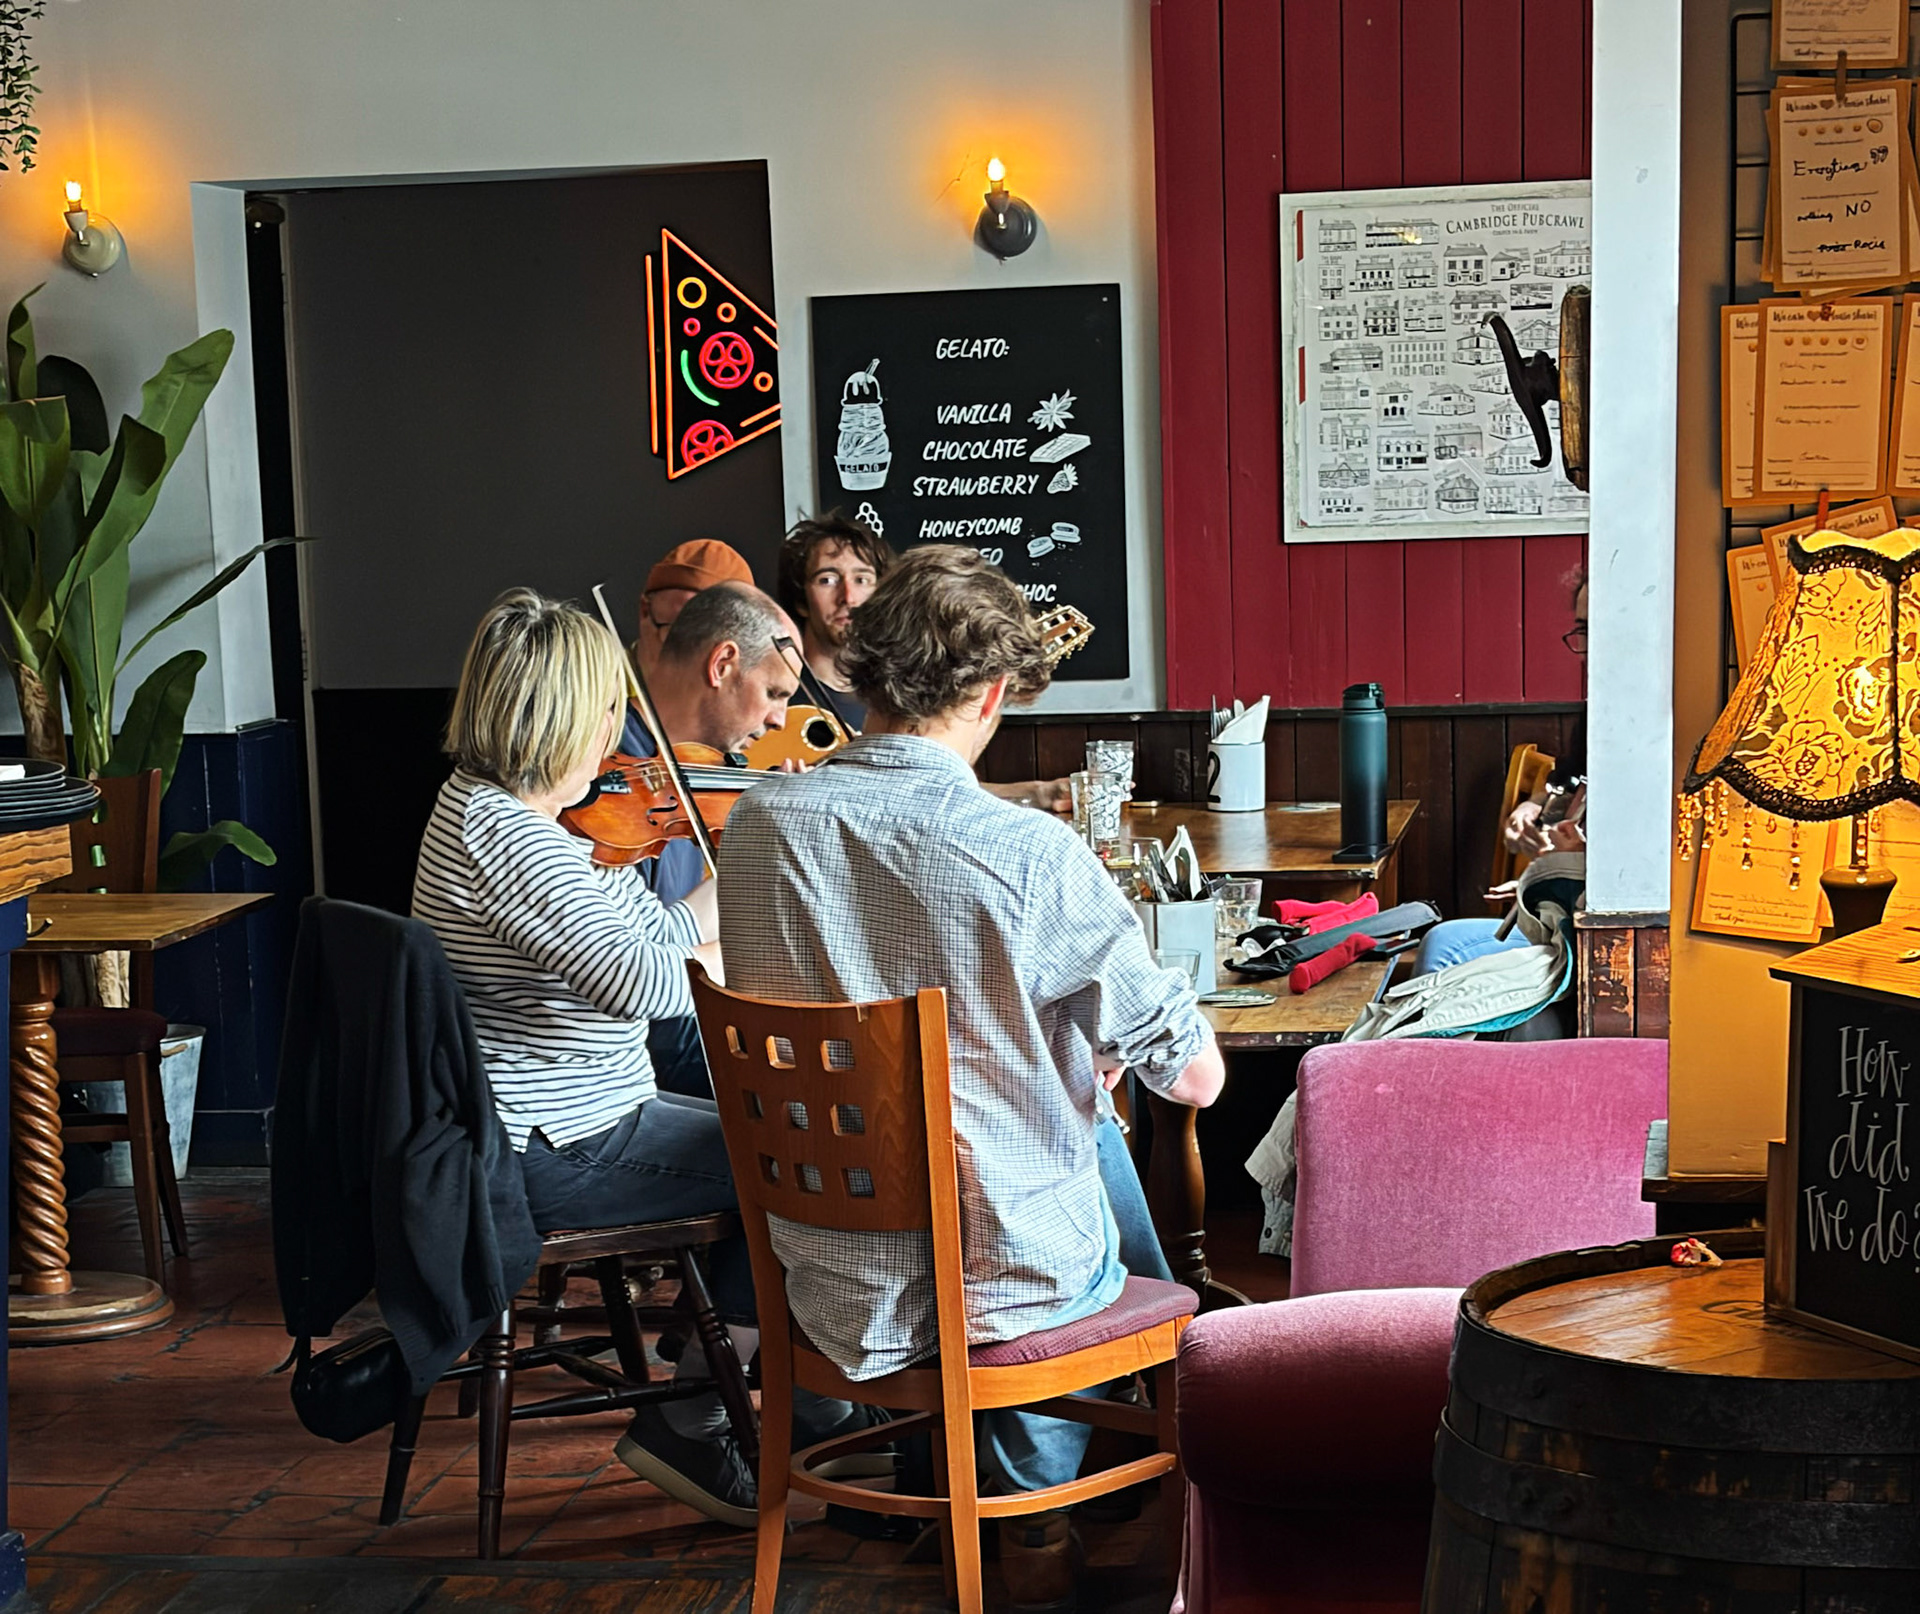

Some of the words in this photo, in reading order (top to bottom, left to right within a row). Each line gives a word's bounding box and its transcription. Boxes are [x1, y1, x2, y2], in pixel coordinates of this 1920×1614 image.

[1846, 199, 1872, 218] NO
[1445, 214, 1518, 235] CAMBRIDGE
[1522, 212, 1585, 229] PUBCRAWL
[936, 338, 1010, 359] GELATO:
[937, 403, 1012, 425] VANILLA
[922, 438, 1028, 461] CHOCOLATE
[912, 474, 1040, 497] STRAWBERRY
[918, 517, 1023, 539] HONEYCOMB
[979, 547, 1003, 566] EO
[1208, 751, 1221, 803] 2
[1838, 1026, 1911, 1098] How
[1829, 1101, 1910, 1186] did
[1804, 1186, 1854, 1252] We
